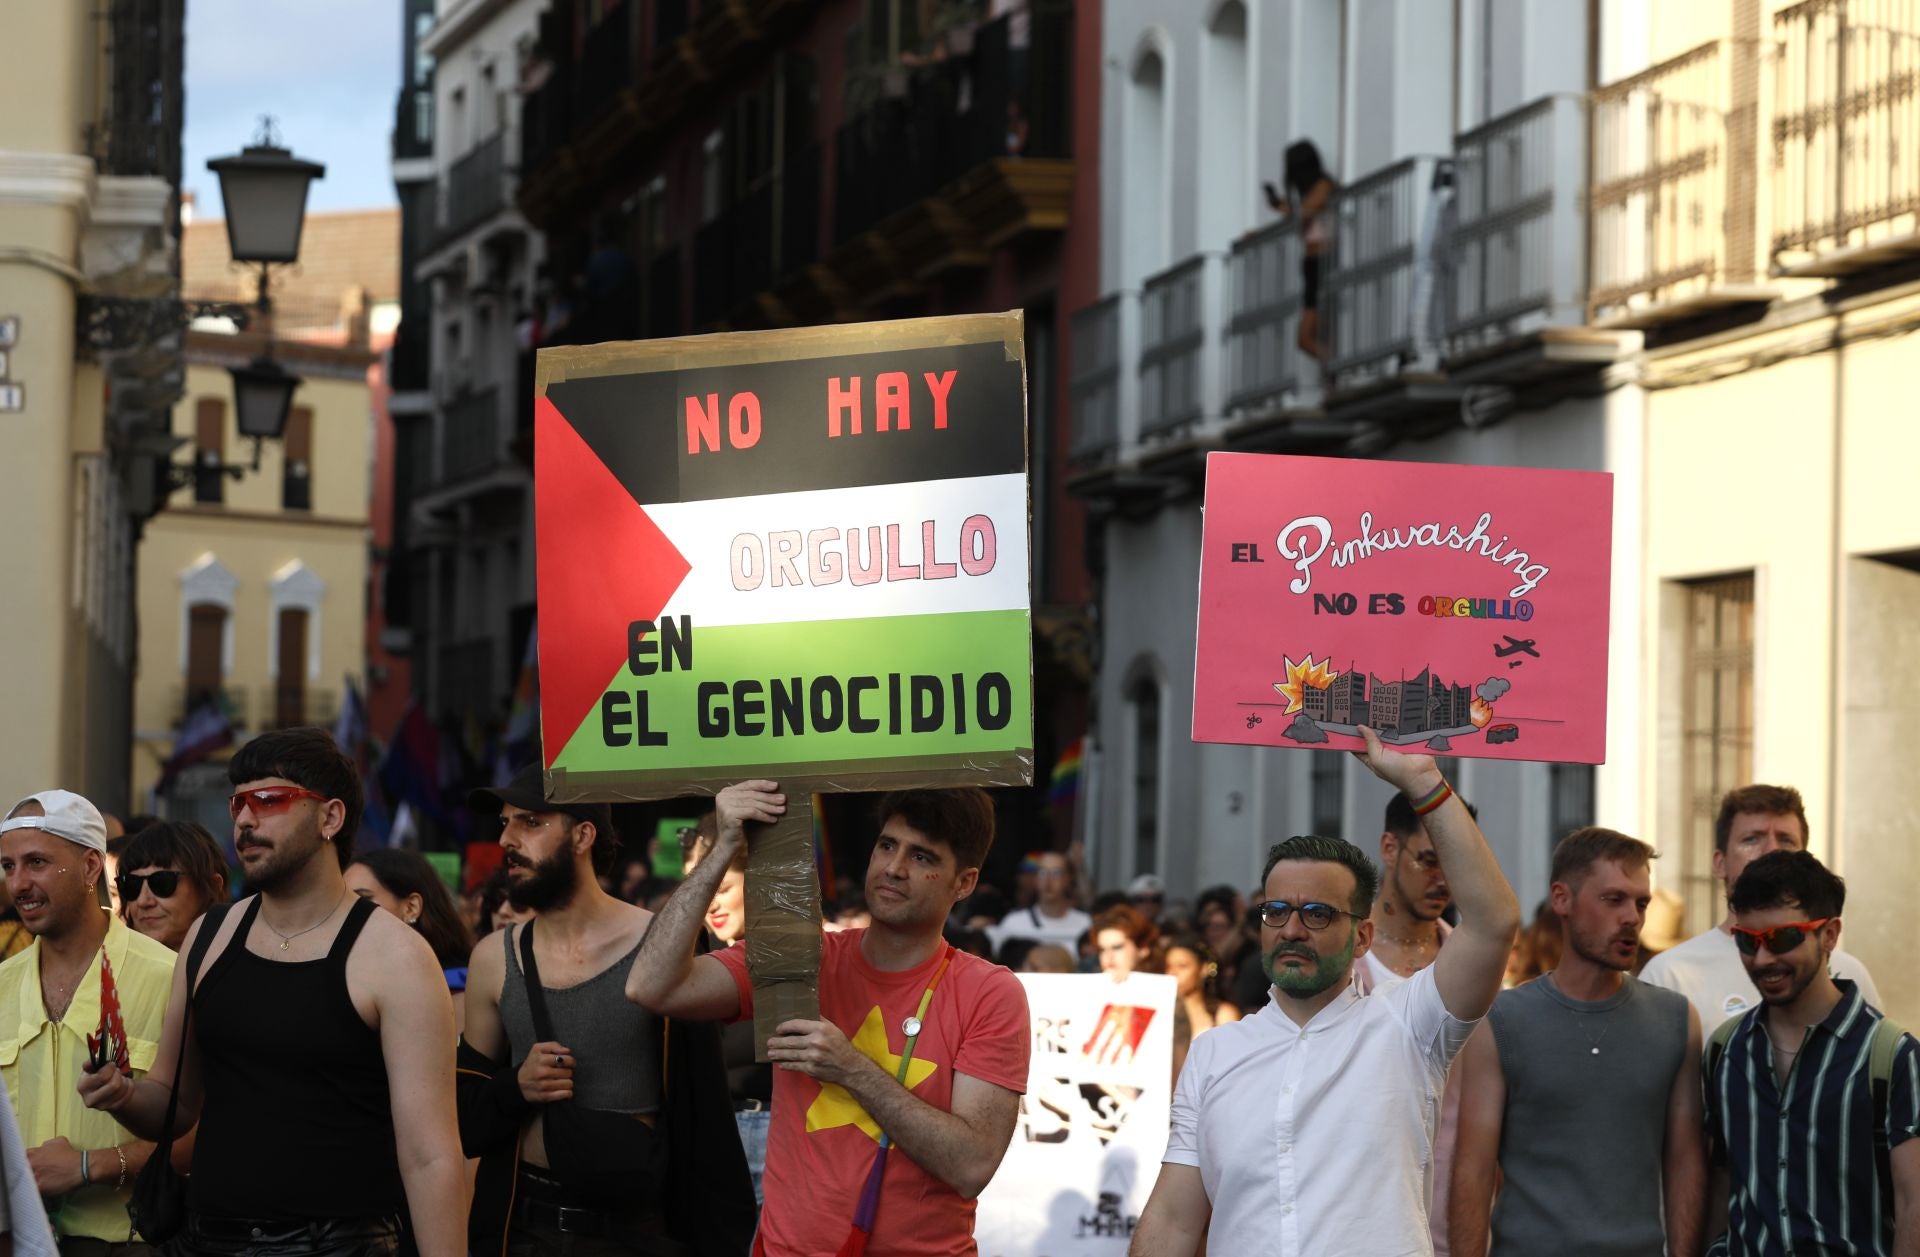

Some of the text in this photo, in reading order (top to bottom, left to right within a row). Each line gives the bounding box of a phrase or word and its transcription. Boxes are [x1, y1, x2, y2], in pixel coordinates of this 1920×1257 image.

[686, 370, 958, 454] NO HAY
[730, 514, 997, 591] ORGULLO
[1231, 511, 1550, 598] EL Pinkwashing
[1313, 592, 1534, 621] NO ES ORGULLO
[627, 615, 693, 677] EN
[601, 672, 1012, 747] EL GENOCIDIO
